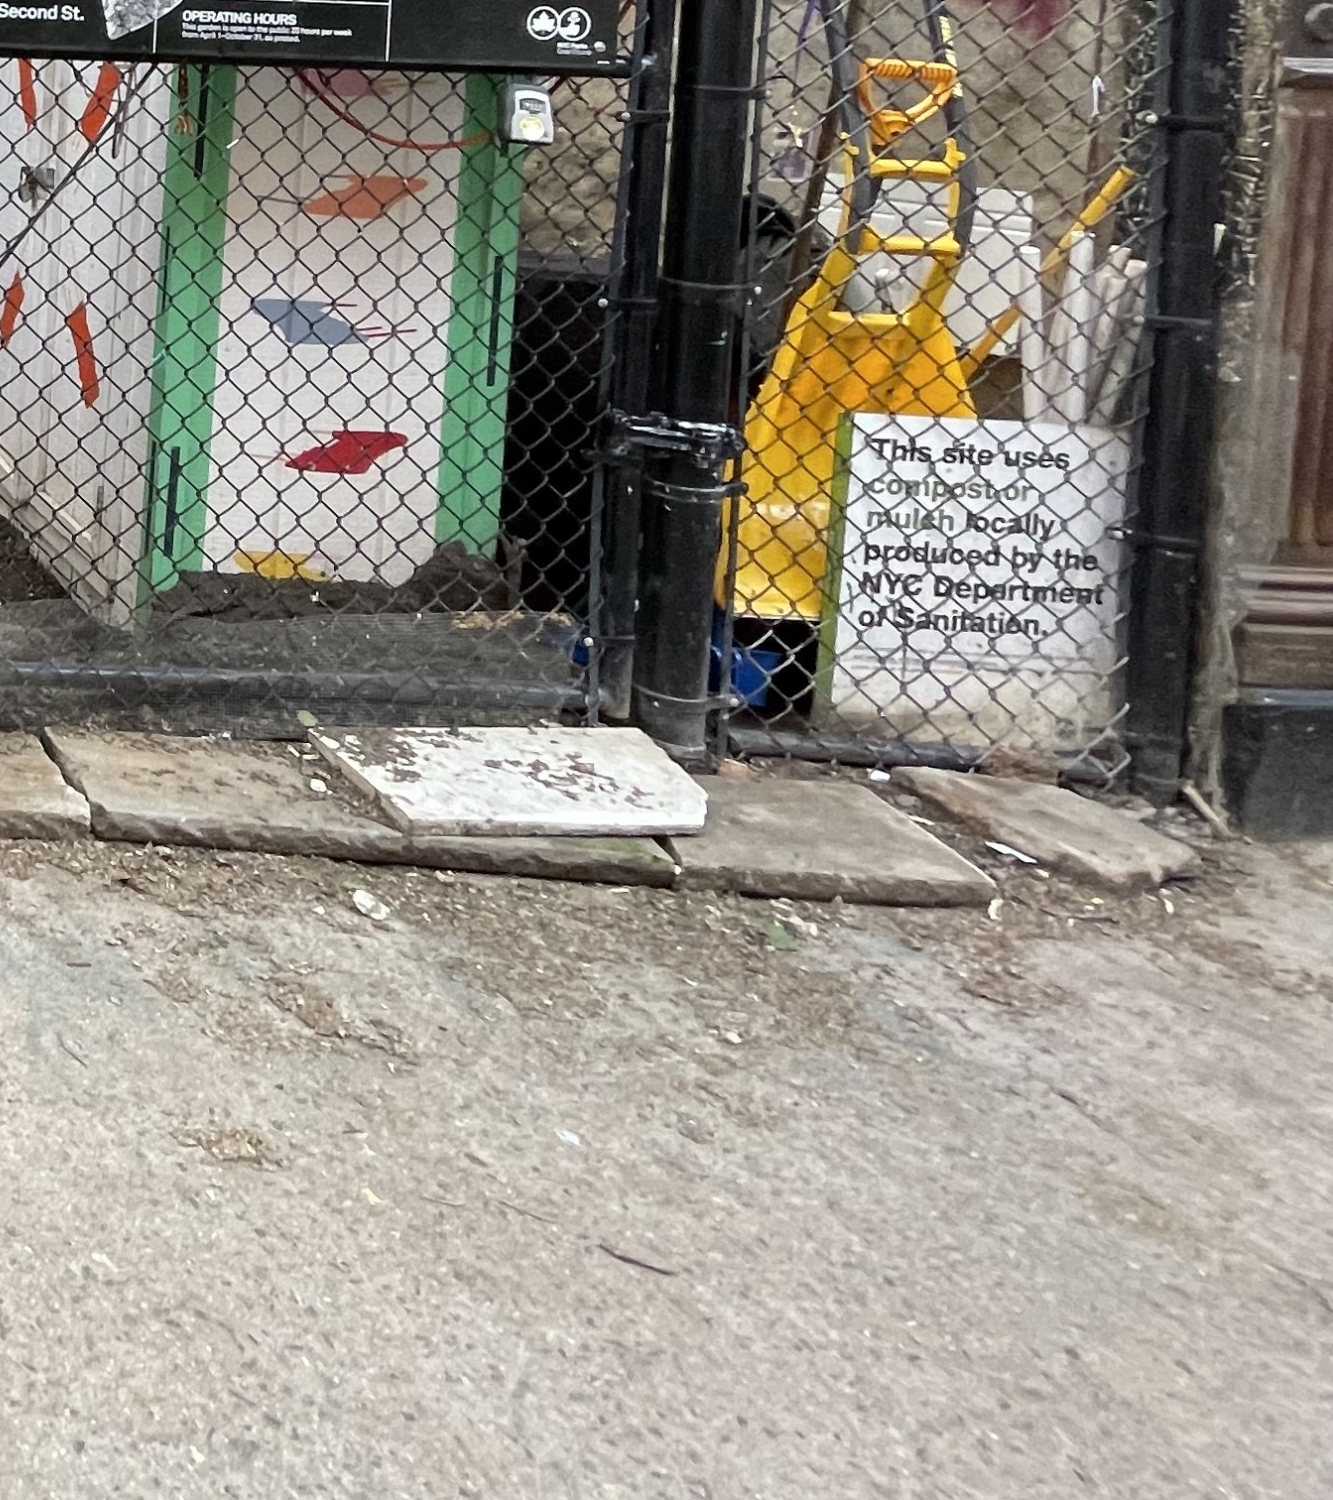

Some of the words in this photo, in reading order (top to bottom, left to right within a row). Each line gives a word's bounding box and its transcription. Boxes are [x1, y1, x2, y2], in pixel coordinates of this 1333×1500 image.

[61, 5, 85, 21] St.
[182, 9, 252, 24] OPERATING
[253, 12, 298, 26] HOURS
[870, 438, 932, 463] This
[942, 442, 994, 465] site
[1005, 451, 1071, 469] uses
[868, 477, 994, 502] compost
[1005, 484, 1035, 501] or
[866, 507, 955, 531] mulch
[967, 510, 1055, 541] locally
[864, 541, 1000, 566] produced
[1012, 545, 1045, 573] by
[1054, 548, 1099, 571] the
[862, 571, 923, 596] NYC
[933, 575, 1105, 605] Department
[858, 605, 886, 627] of
[895, 606, 1050, 636] Sanitation.
